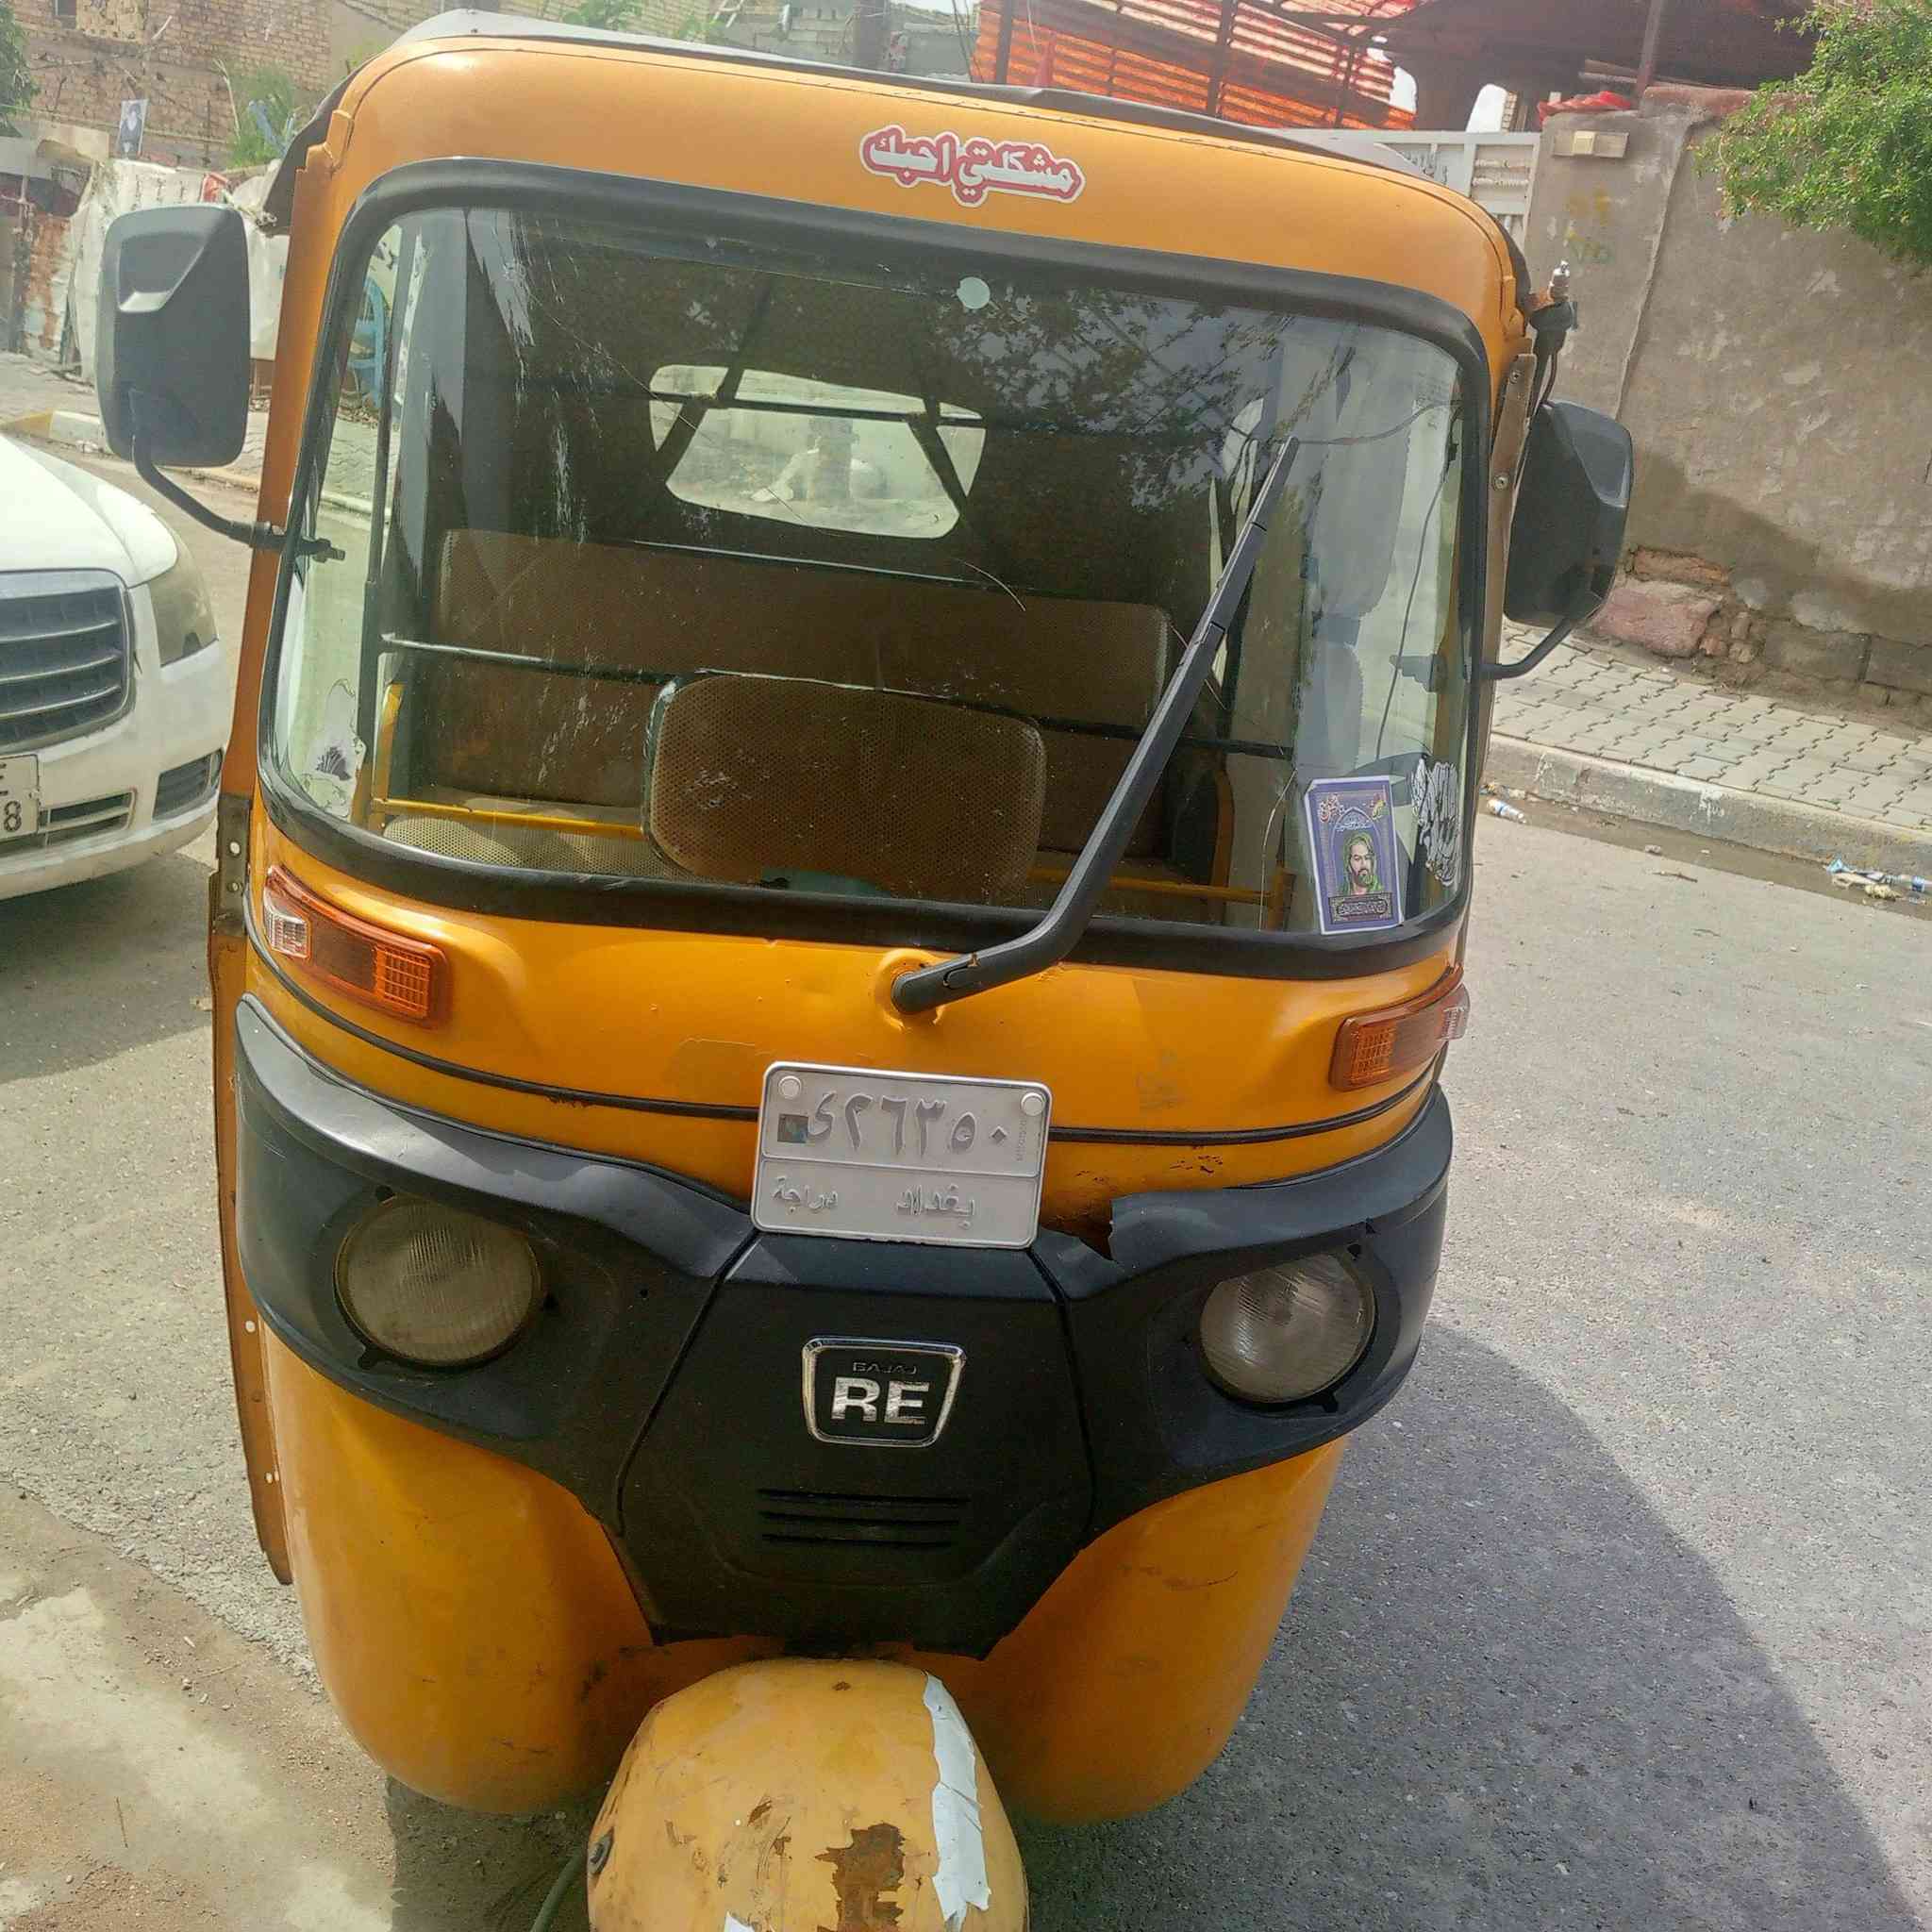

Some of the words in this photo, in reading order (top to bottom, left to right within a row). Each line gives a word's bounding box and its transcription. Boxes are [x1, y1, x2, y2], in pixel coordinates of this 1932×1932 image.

[958, 145, 1074, 197] مشكلتي
[773, 1176, 839, 1214] دراجة
[896, 1182, 975, 1229] بغداد
[830, 1375, 930, 1425] RE
